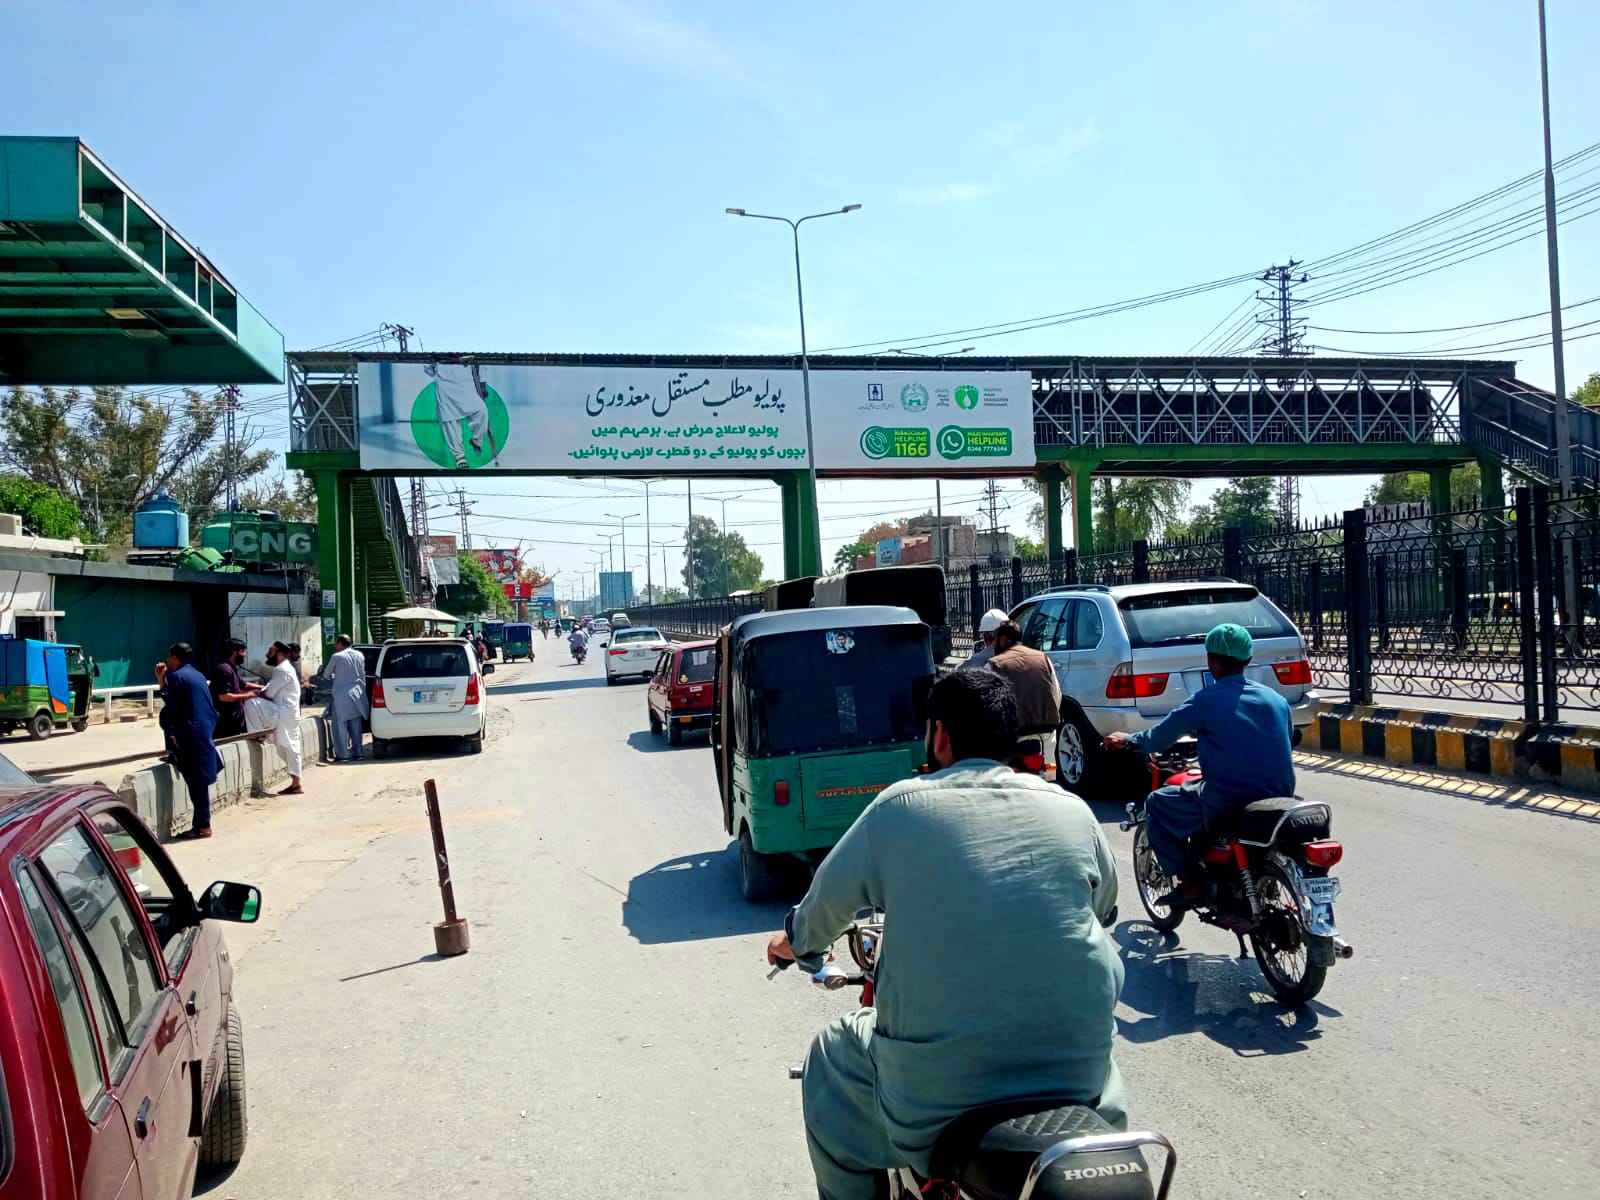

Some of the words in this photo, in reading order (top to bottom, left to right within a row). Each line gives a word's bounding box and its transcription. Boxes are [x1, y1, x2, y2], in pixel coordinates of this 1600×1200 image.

[586, 385, 650, 417] معذوری
[652, 372, 710, 417] مستقل
[702, 377, 752, 417] مطلب
[753, 378, 785, 413] پولیو
[592, 426, 618, 438] میں
[683, 424, 714, 438] مرض
[715, 425, 747, 439] لاعلاج
[748, 425, 779, 439] پولیو
[967, 436, 1007, 445] HELPLINE
[621, 447, 654, 460] لازمی
[656, 446, 692, 460] قطرے
[693, 449, 708, 460] دو
[709, 446, 726, 460] کے
[727, 447, 759, 461] پولیو
[760, 445, 776, 460] کو
[777, 448, 807, 461] بچوں
[895, 442, 927, 456] 1166
[233, 530, 311, 554] CNG
[1290, 815, 1325, 828] UNITED
[1063, 1161, 1144, 1181] HONDA
